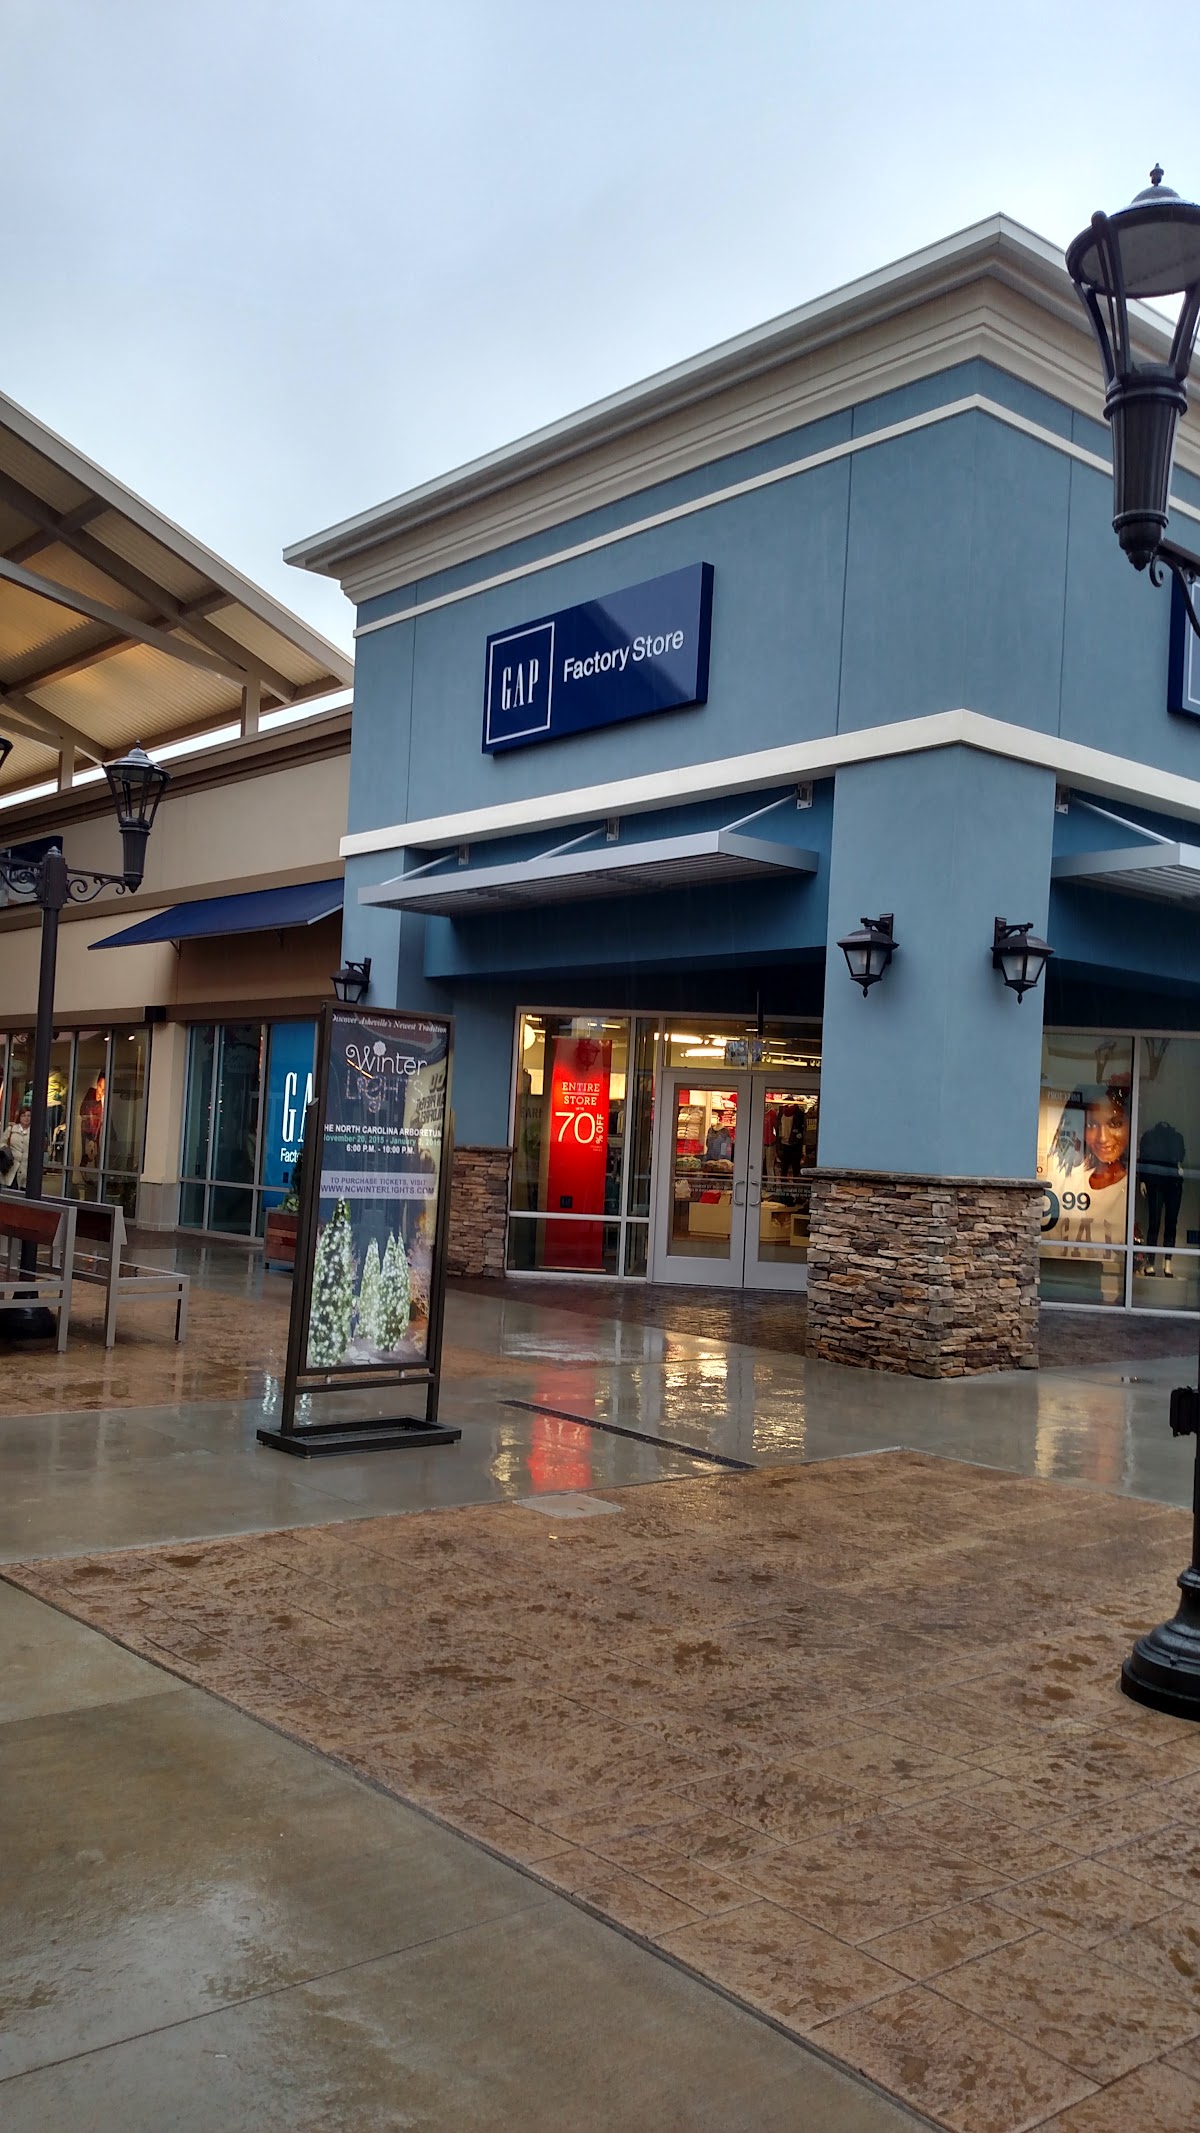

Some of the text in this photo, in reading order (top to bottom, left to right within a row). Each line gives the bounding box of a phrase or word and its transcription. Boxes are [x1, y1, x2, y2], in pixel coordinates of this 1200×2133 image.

[563, 630, 684, 683] Factory Store
[501, 658, 539, 711] GAP
[358, 1016, 392, 1029] Asheville's
[393, 1020, 416, 1031] Newest
[418, 1021, 447, 1034] Tradition
[345, 1040, 428, 1076] Winter
[561, 1082, 601, 1093] ENTIRE
[282, 1072, 313, 1143] GA
[563, 1095, 597, 1106] STORE
[323, 1123, 334, 1133] HE
[335, 1124, 360, 1134] NORTH
[361, 1125, 399, 1136] CAROLINA
[555, 1112, 596, 1144] 70
[323, 1133, 356, 1143] ovember
[368, 1135, 385, 1144] 2015
[390, 1136, 417, 1147] January
[346, 1143, 361, 1152] 6:00
[362, 1144, 377, 1153] P.M.
[382, 1145, 400, 1154] 10:00
[401, 1146, 415, 1155] P.M.
[331, 1176, 340, 1184] TO
[341, 1177, 377, 1185] PURCHASE
[410, 1179, 426, 1187] VISIT
[320, 1184, 435, 1195] WWW.NCWINTERLIGHTS.COM
